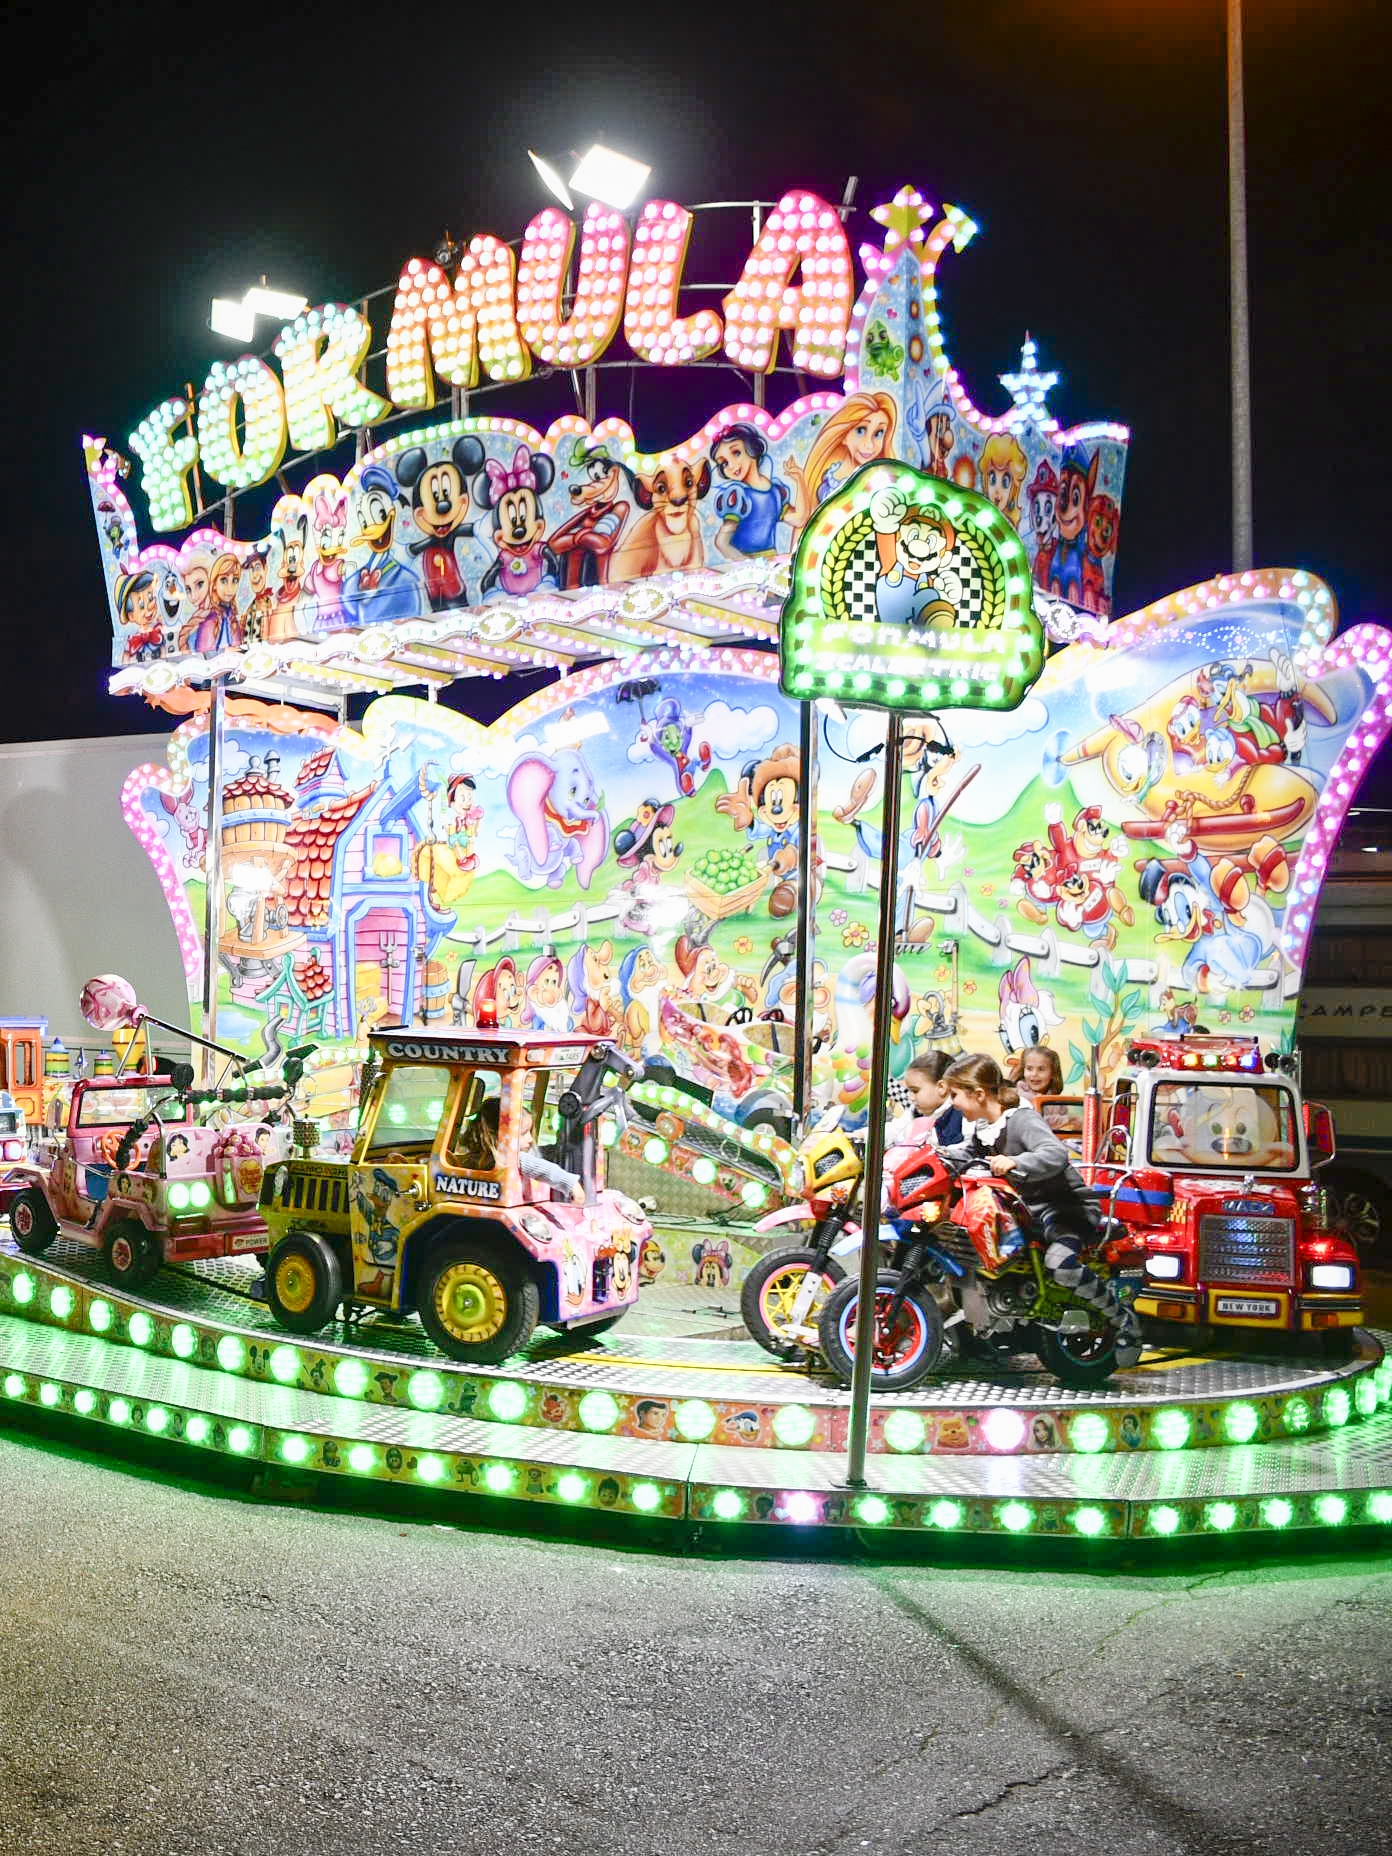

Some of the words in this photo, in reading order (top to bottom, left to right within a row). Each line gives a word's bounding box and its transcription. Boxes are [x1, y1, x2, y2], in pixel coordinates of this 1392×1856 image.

[128, 188, 854, 534] FORMULA
[388, 1042, 509, 1064] COUNTRY
[435, 1175, 500, 1200] NATURE
[1222, 1302, 1245, 1311] NEW
[1247, 1302, 1271, 1312] YORK
